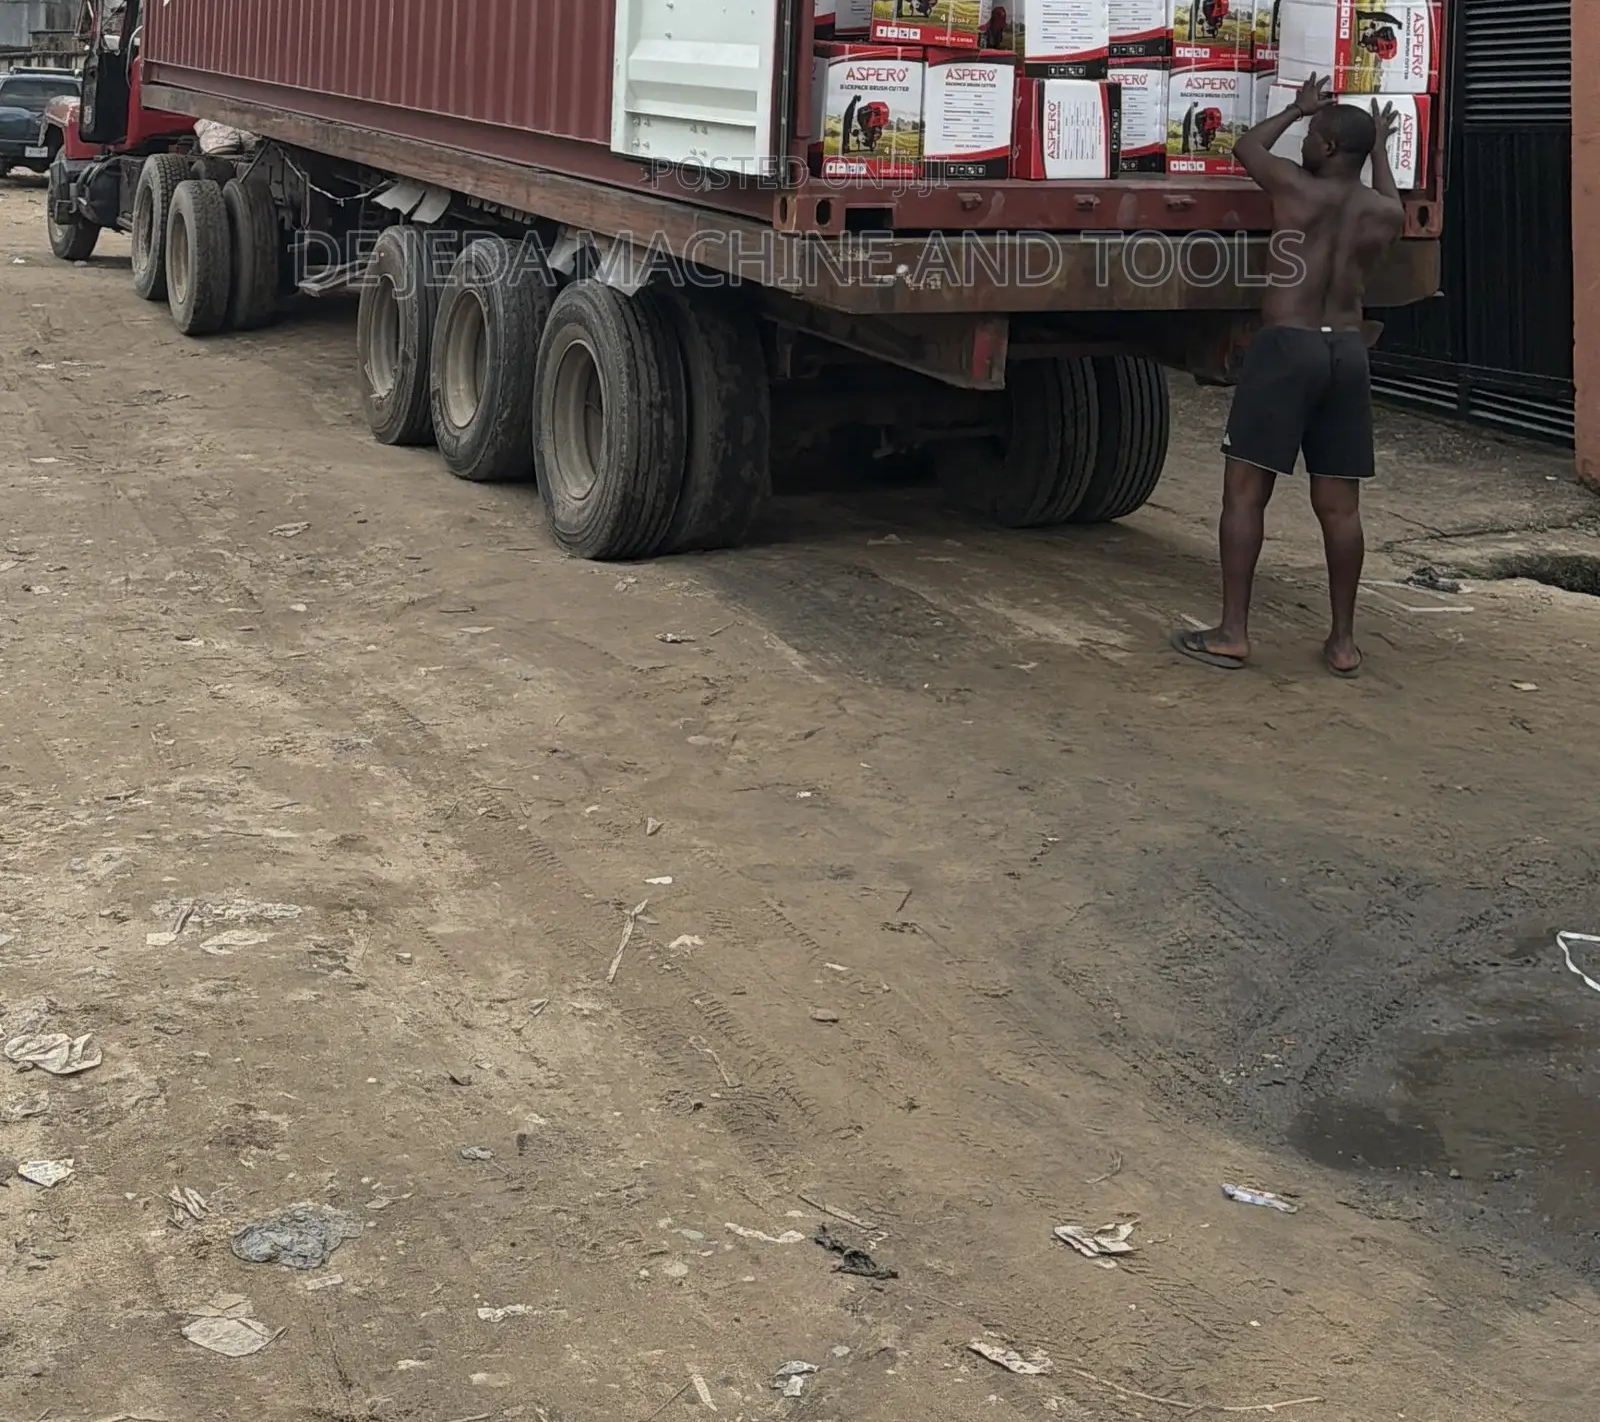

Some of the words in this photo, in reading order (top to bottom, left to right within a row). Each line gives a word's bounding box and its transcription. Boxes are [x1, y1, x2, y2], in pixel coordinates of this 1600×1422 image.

[1411, 12, 1424, 77] ASPERO
[846, 67, 907, 82] ASPERO
[946, 68, 996, 81] ASPERO
[1110, 74, 1148, 85] SPERO
[1185, 77, 1237, 91] ASPERO
[1048, 102, 1057, 160] ASPERO
[1400, 113, 1413, 169] ASPERO
